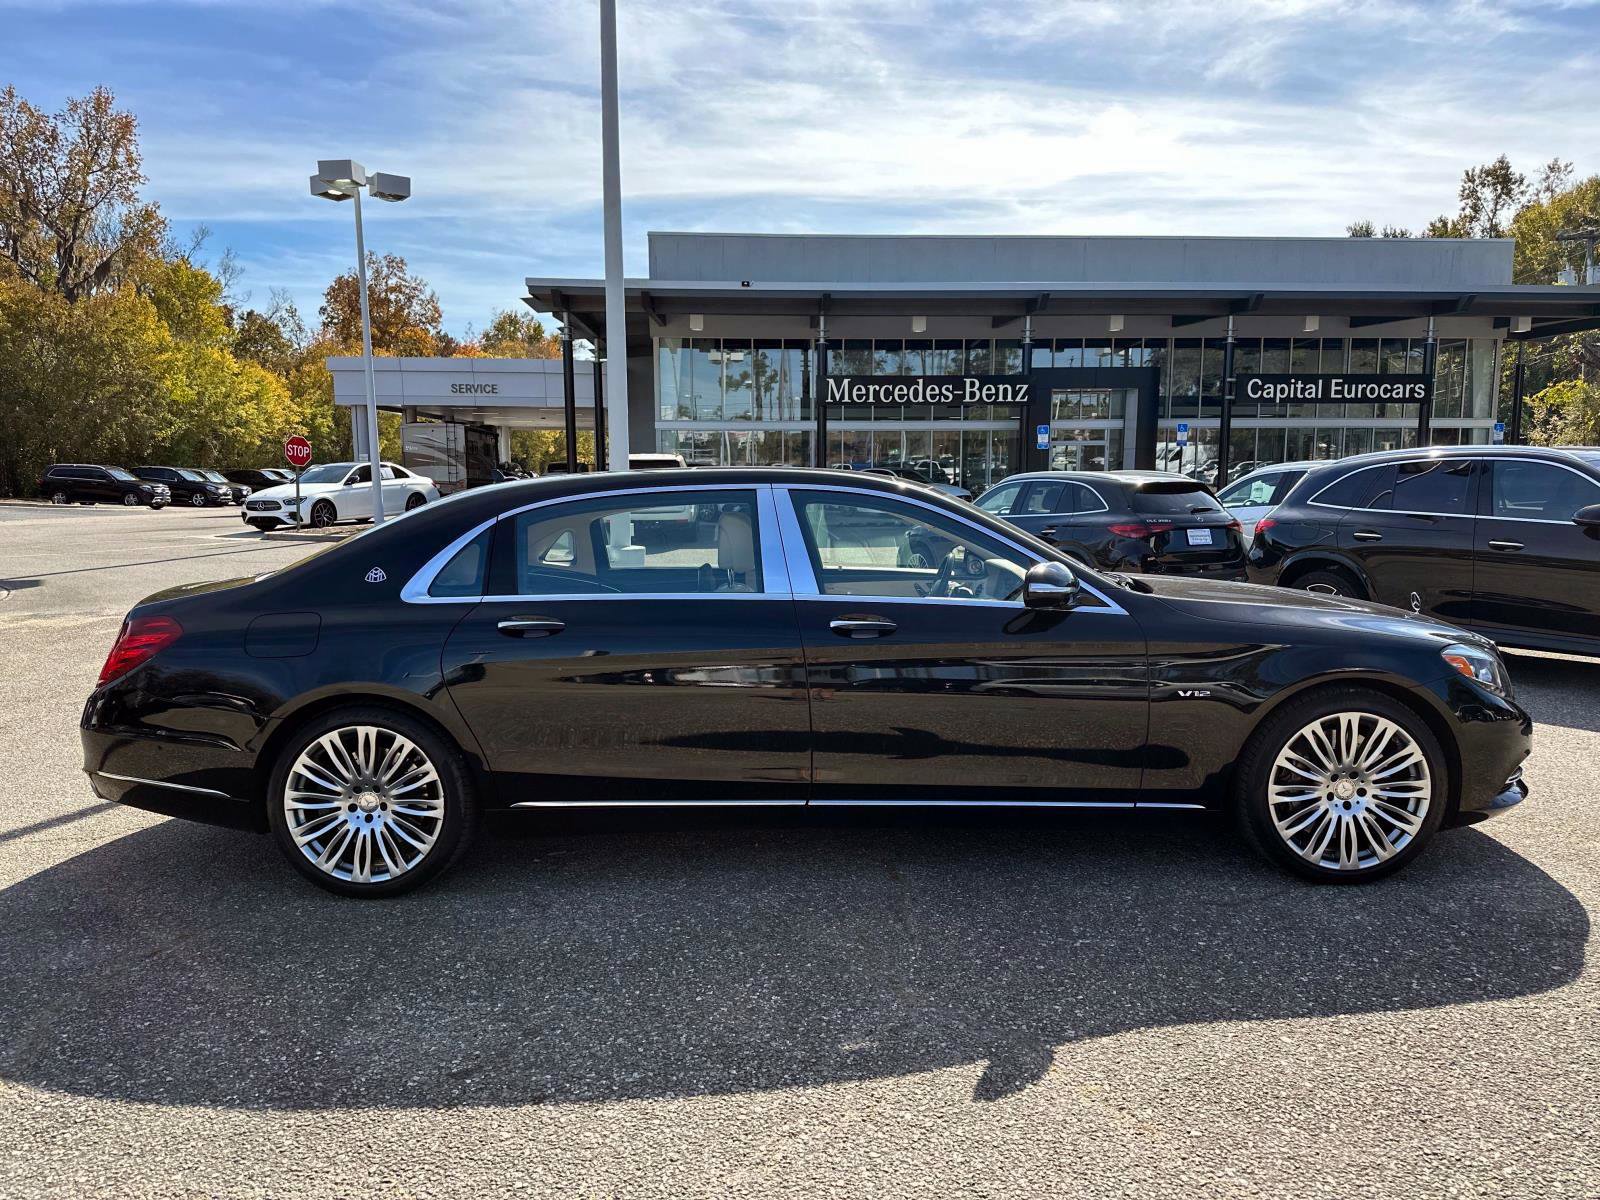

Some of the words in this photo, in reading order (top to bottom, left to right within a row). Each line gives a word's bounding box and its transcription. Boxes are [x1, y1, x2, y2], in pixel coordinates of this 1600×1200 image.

[450, 383, 498, 394] SERVICE
[826, 378, 1029, 403] Mercedes-Benz
[1247, 378, 1322, 403] Capital
[1330, 379, 1425, 399] Eurocars
[287, 444, 310, 457] STOP
